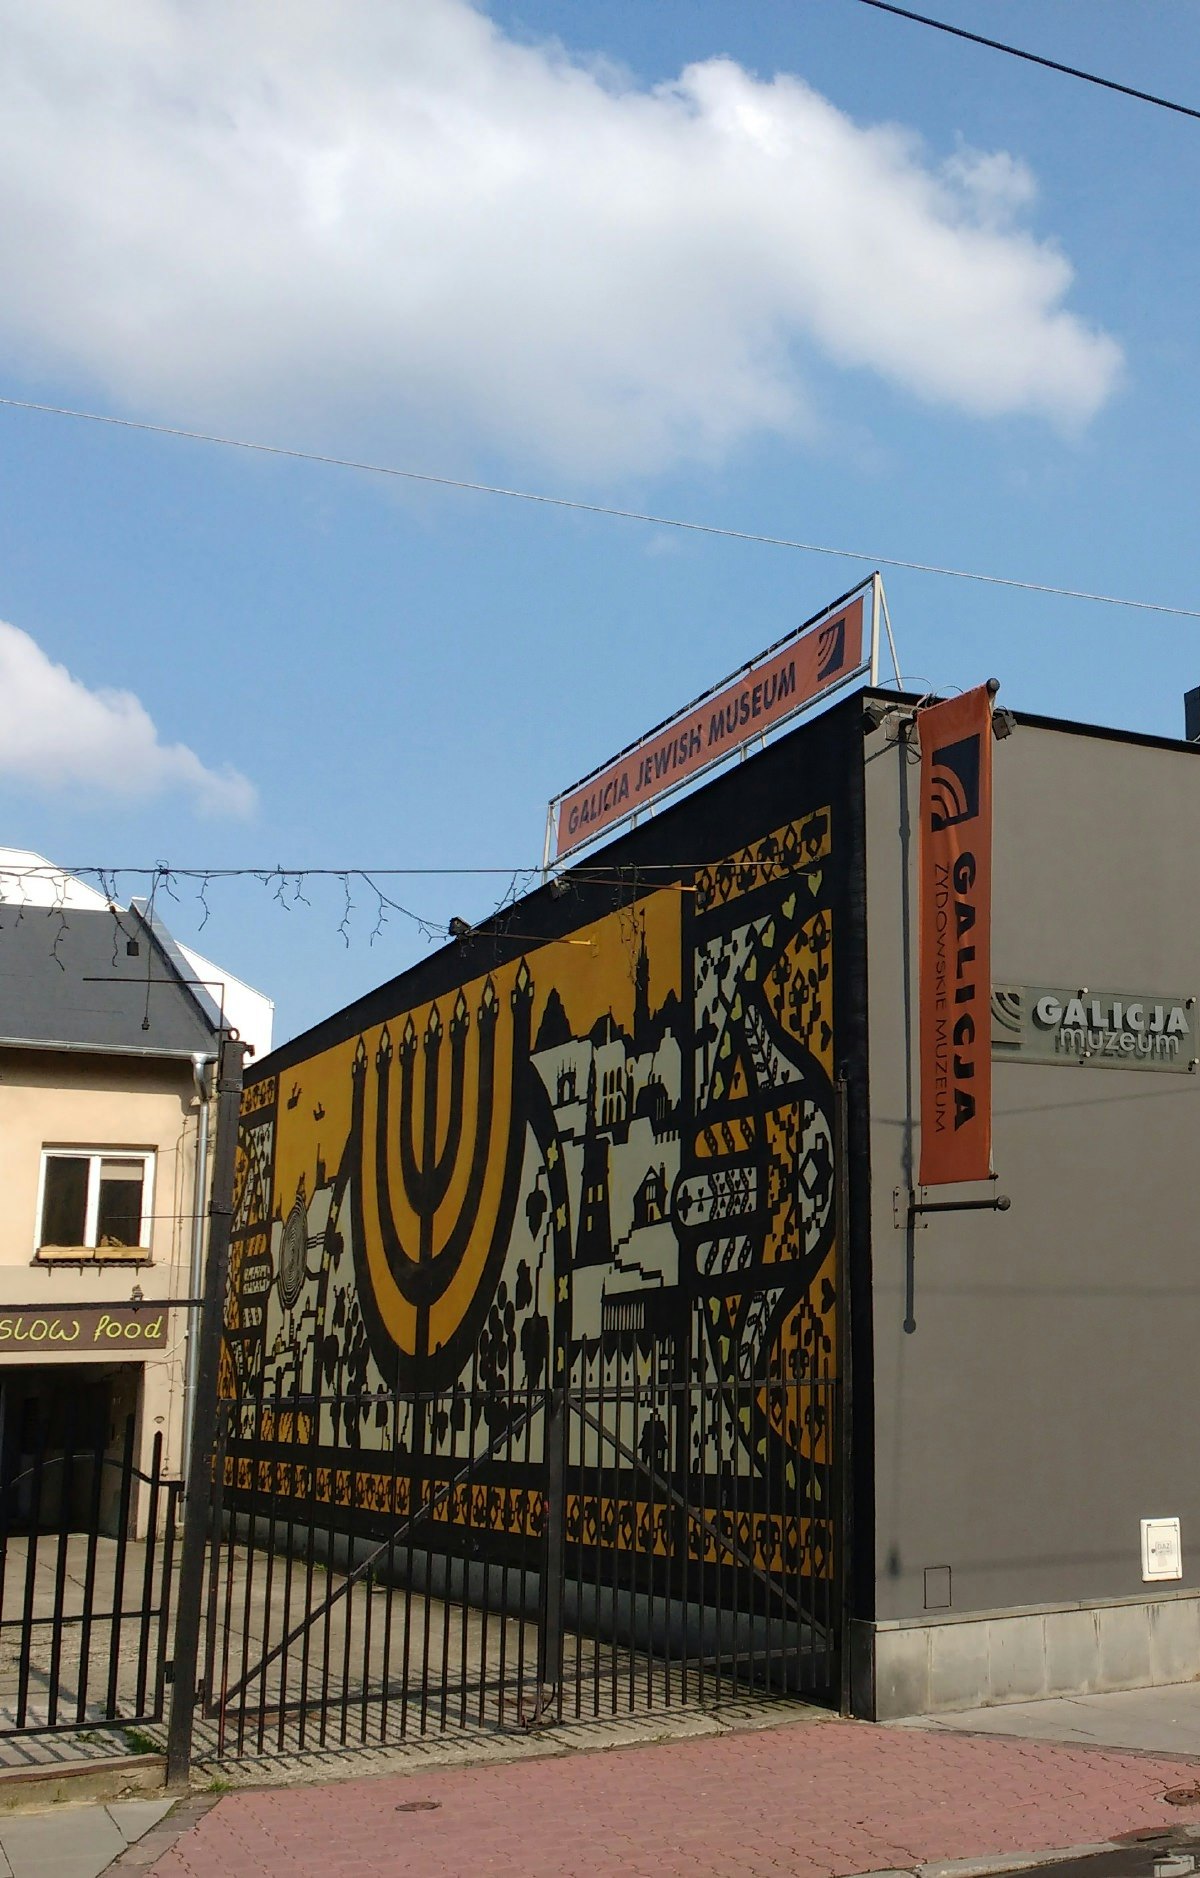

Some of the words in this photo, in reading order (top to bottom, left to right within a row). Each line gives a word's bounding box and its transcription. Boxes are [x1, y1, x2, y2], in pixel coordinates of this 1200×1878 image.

[568, 772, 630, 835] GALICIA
[635, 722, 703, 793] JEWISH
[707, 661, 797, 747] MUSEUM
[952, 851, 977, 1132] GALICJA
[1036, 995, 1190, 1034] GALICJA
[935, 1019, 948, 1134] MUZEUM
[1060, 1027, 1180, 1055] muzeum
[0, 1318, 80, 1341] SLOW
[94, 1315, 163, 1342] food
